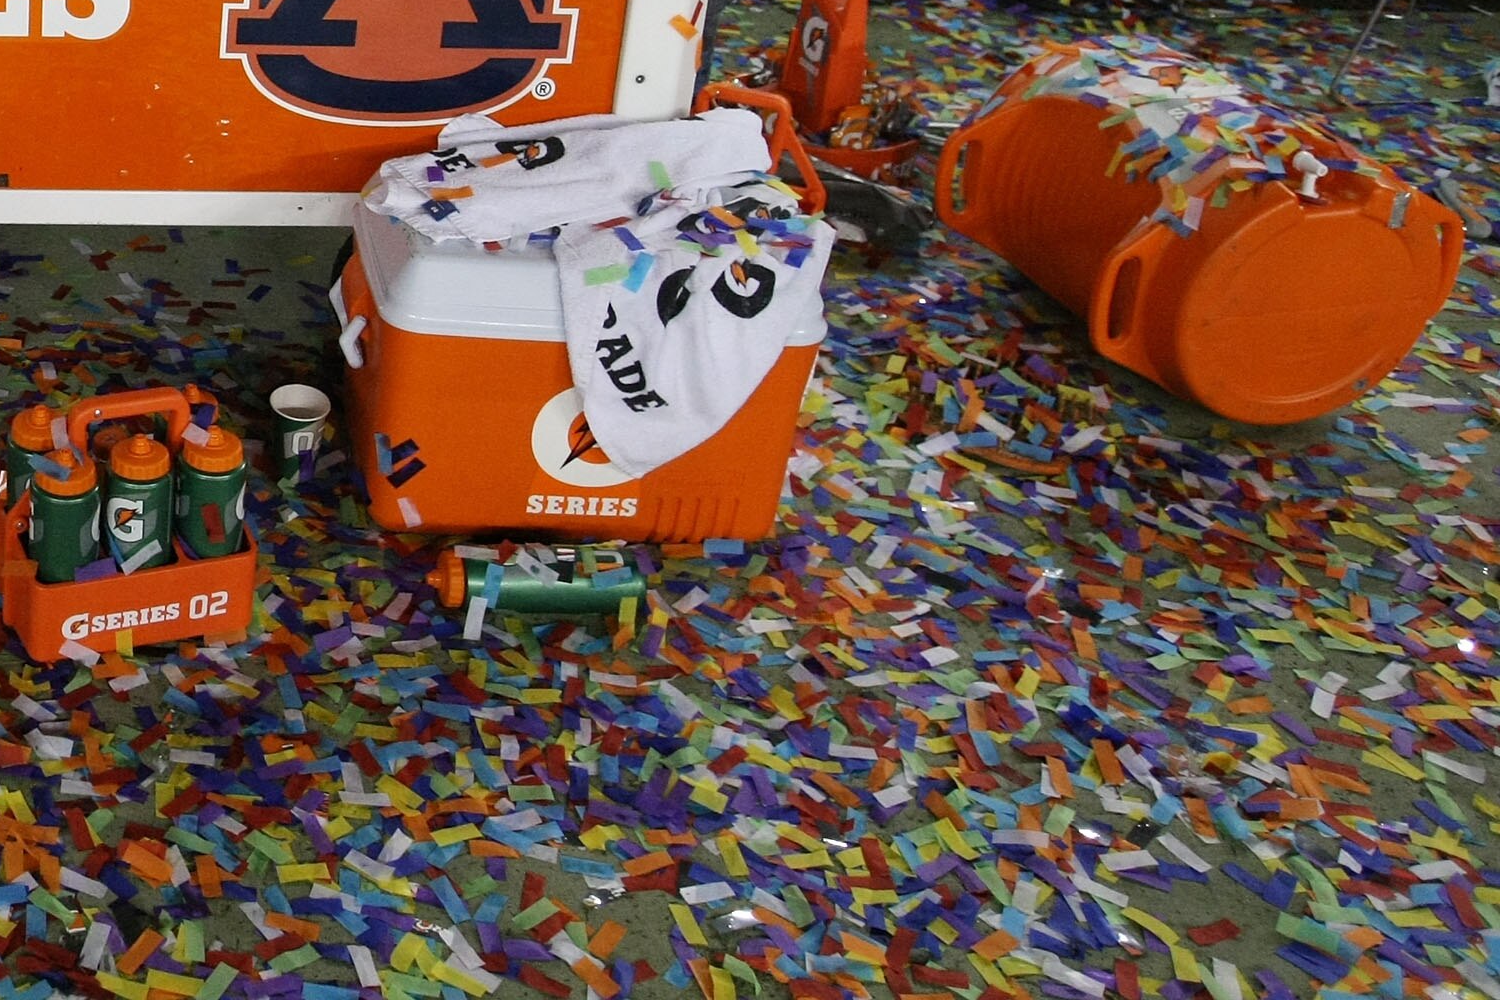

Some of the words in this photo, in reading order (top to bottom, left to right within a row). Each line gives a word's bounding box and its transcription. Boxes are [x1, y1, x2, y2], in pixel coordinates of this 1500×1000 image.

[106, 496, 145, 543] G
[526, 494, 638, 518] SERIES
[188, 589, 229, 621] 02
